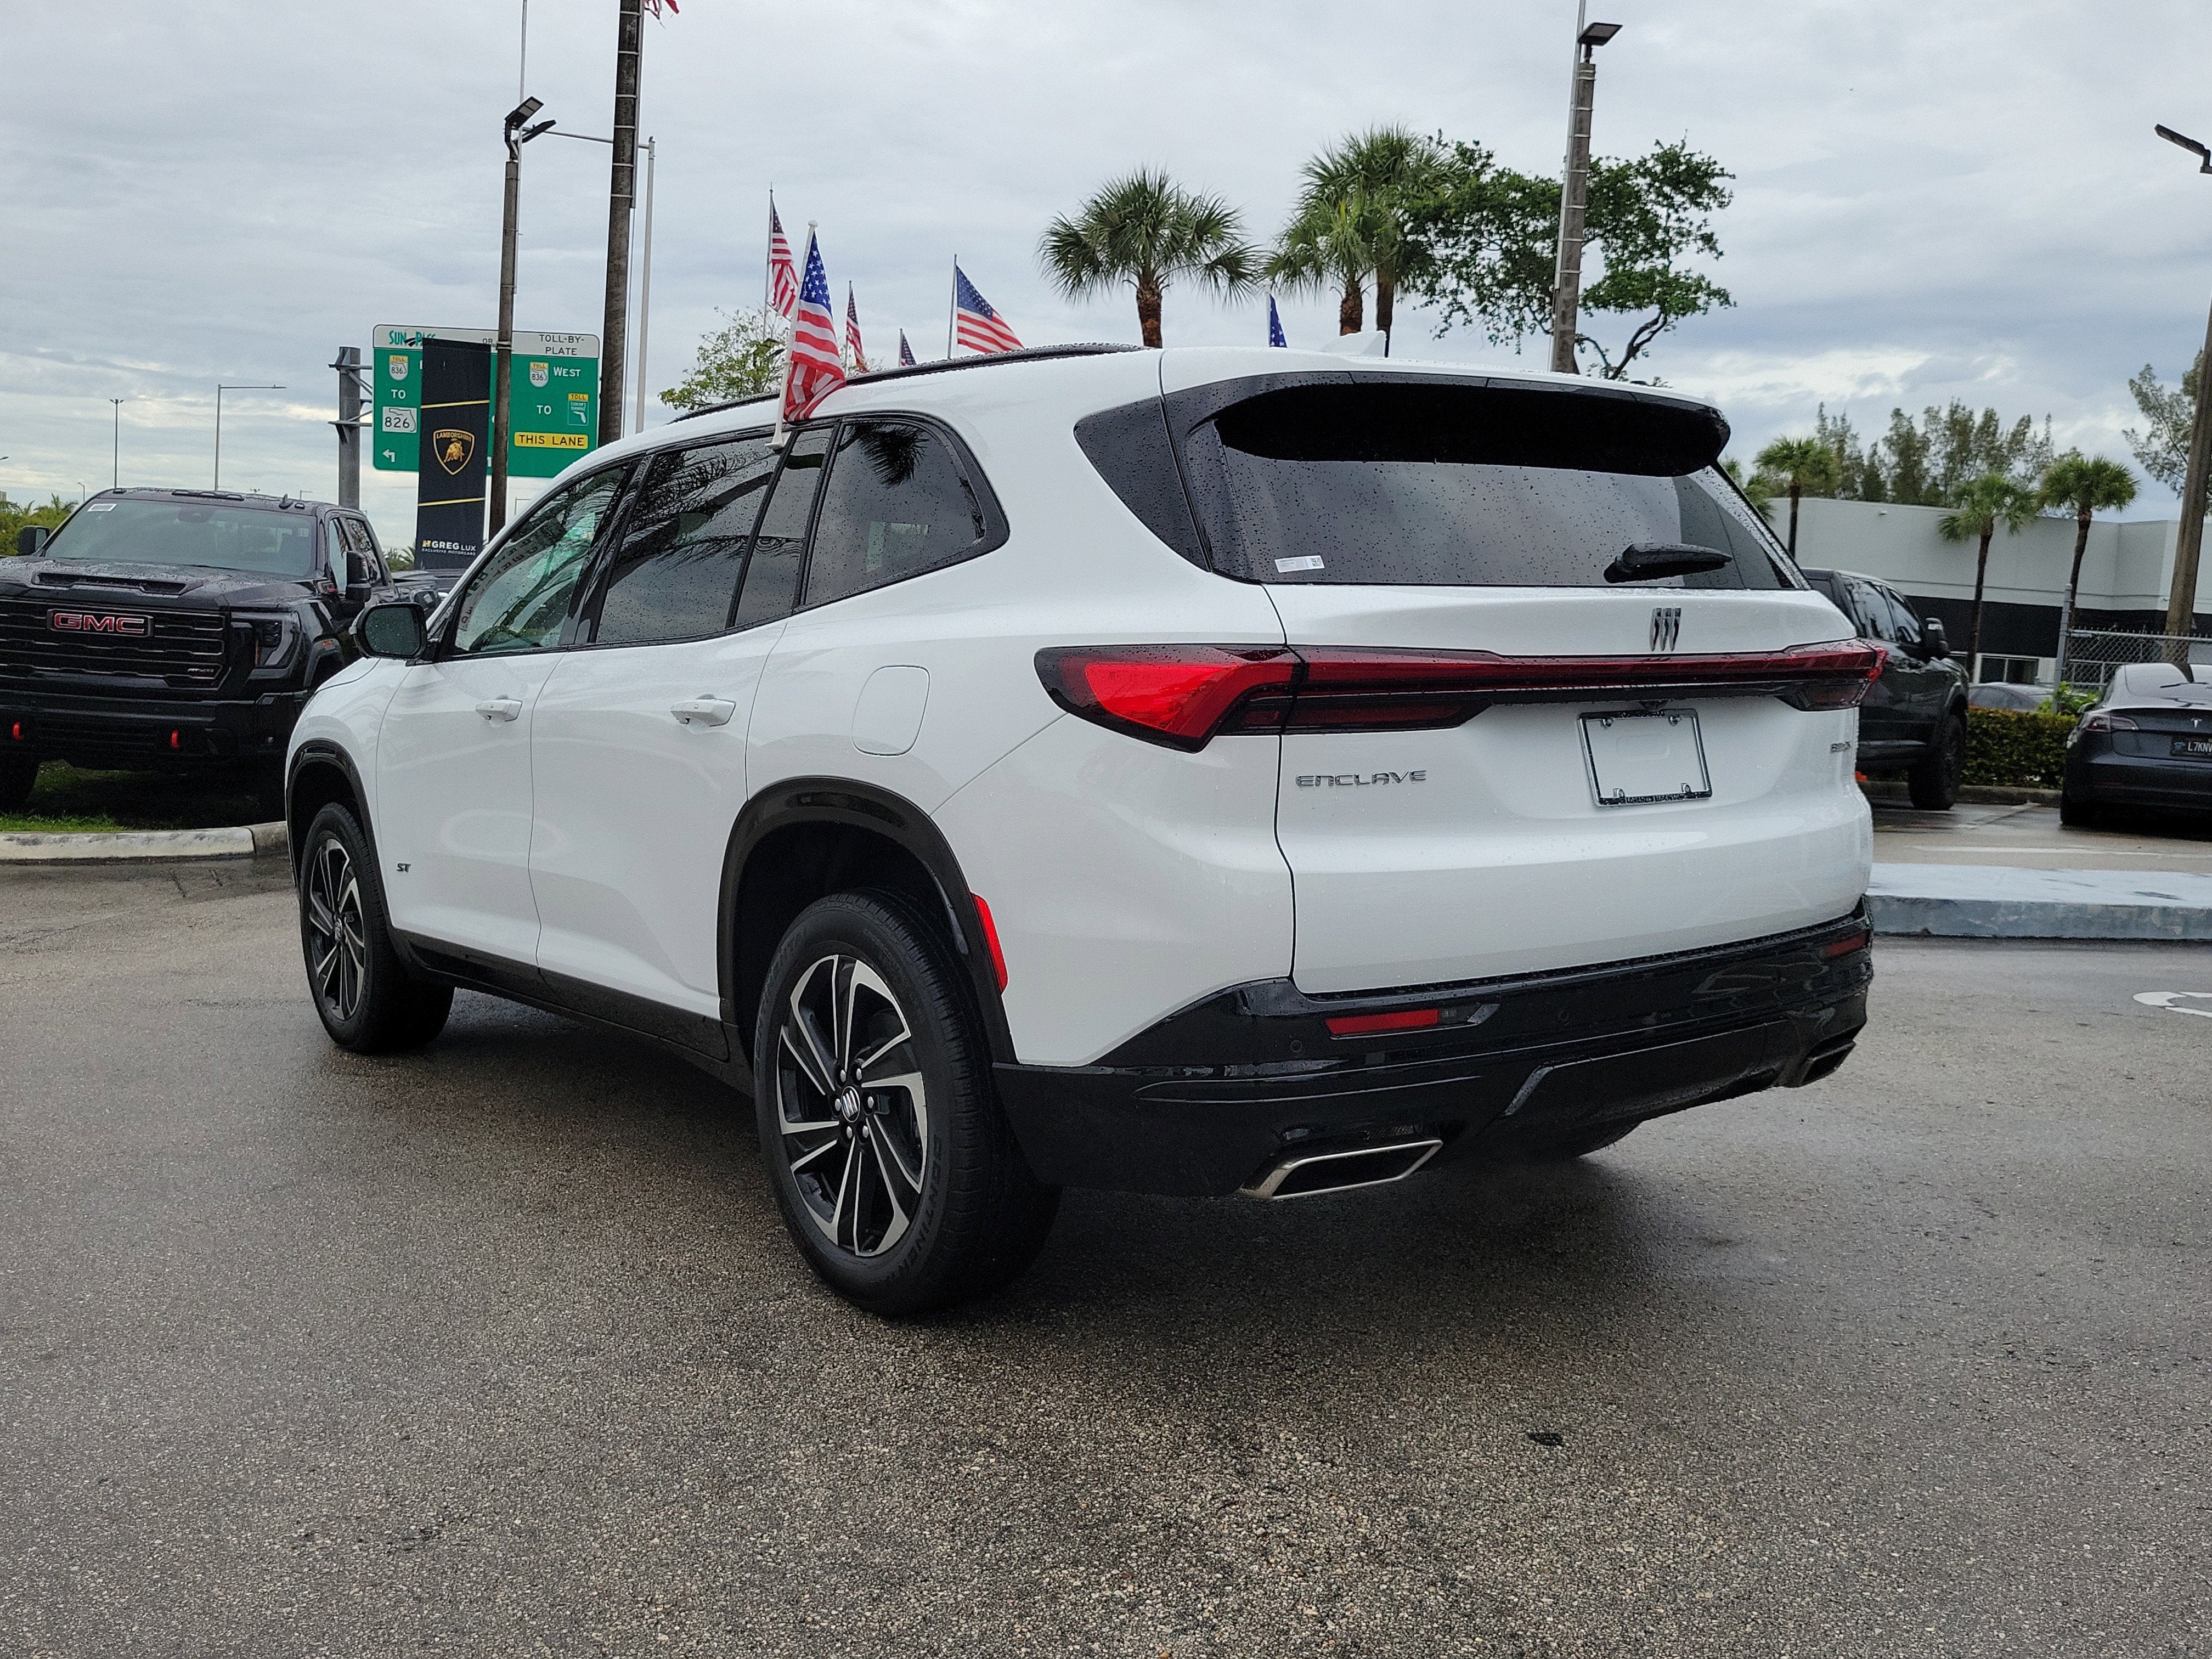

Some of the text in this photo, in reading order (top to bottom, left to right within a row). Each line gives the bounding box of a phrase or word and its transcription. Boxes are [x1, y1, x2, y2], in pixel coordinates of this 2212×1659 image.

[539, 334, 585, 343] TOLL-BY-
[545, 347, 578, 356] PLATE
[391, 390, 406, 399] TO
[536, 405, 552, 415] TO
[385, 417, 410, 428] 826
[518, 435, 584, 446] THIS LANE
[54, 613, 144, 633] GMC
[1295, 770, 1426, 787] ENCLAVE
[396, 863, 411, 872] ST
